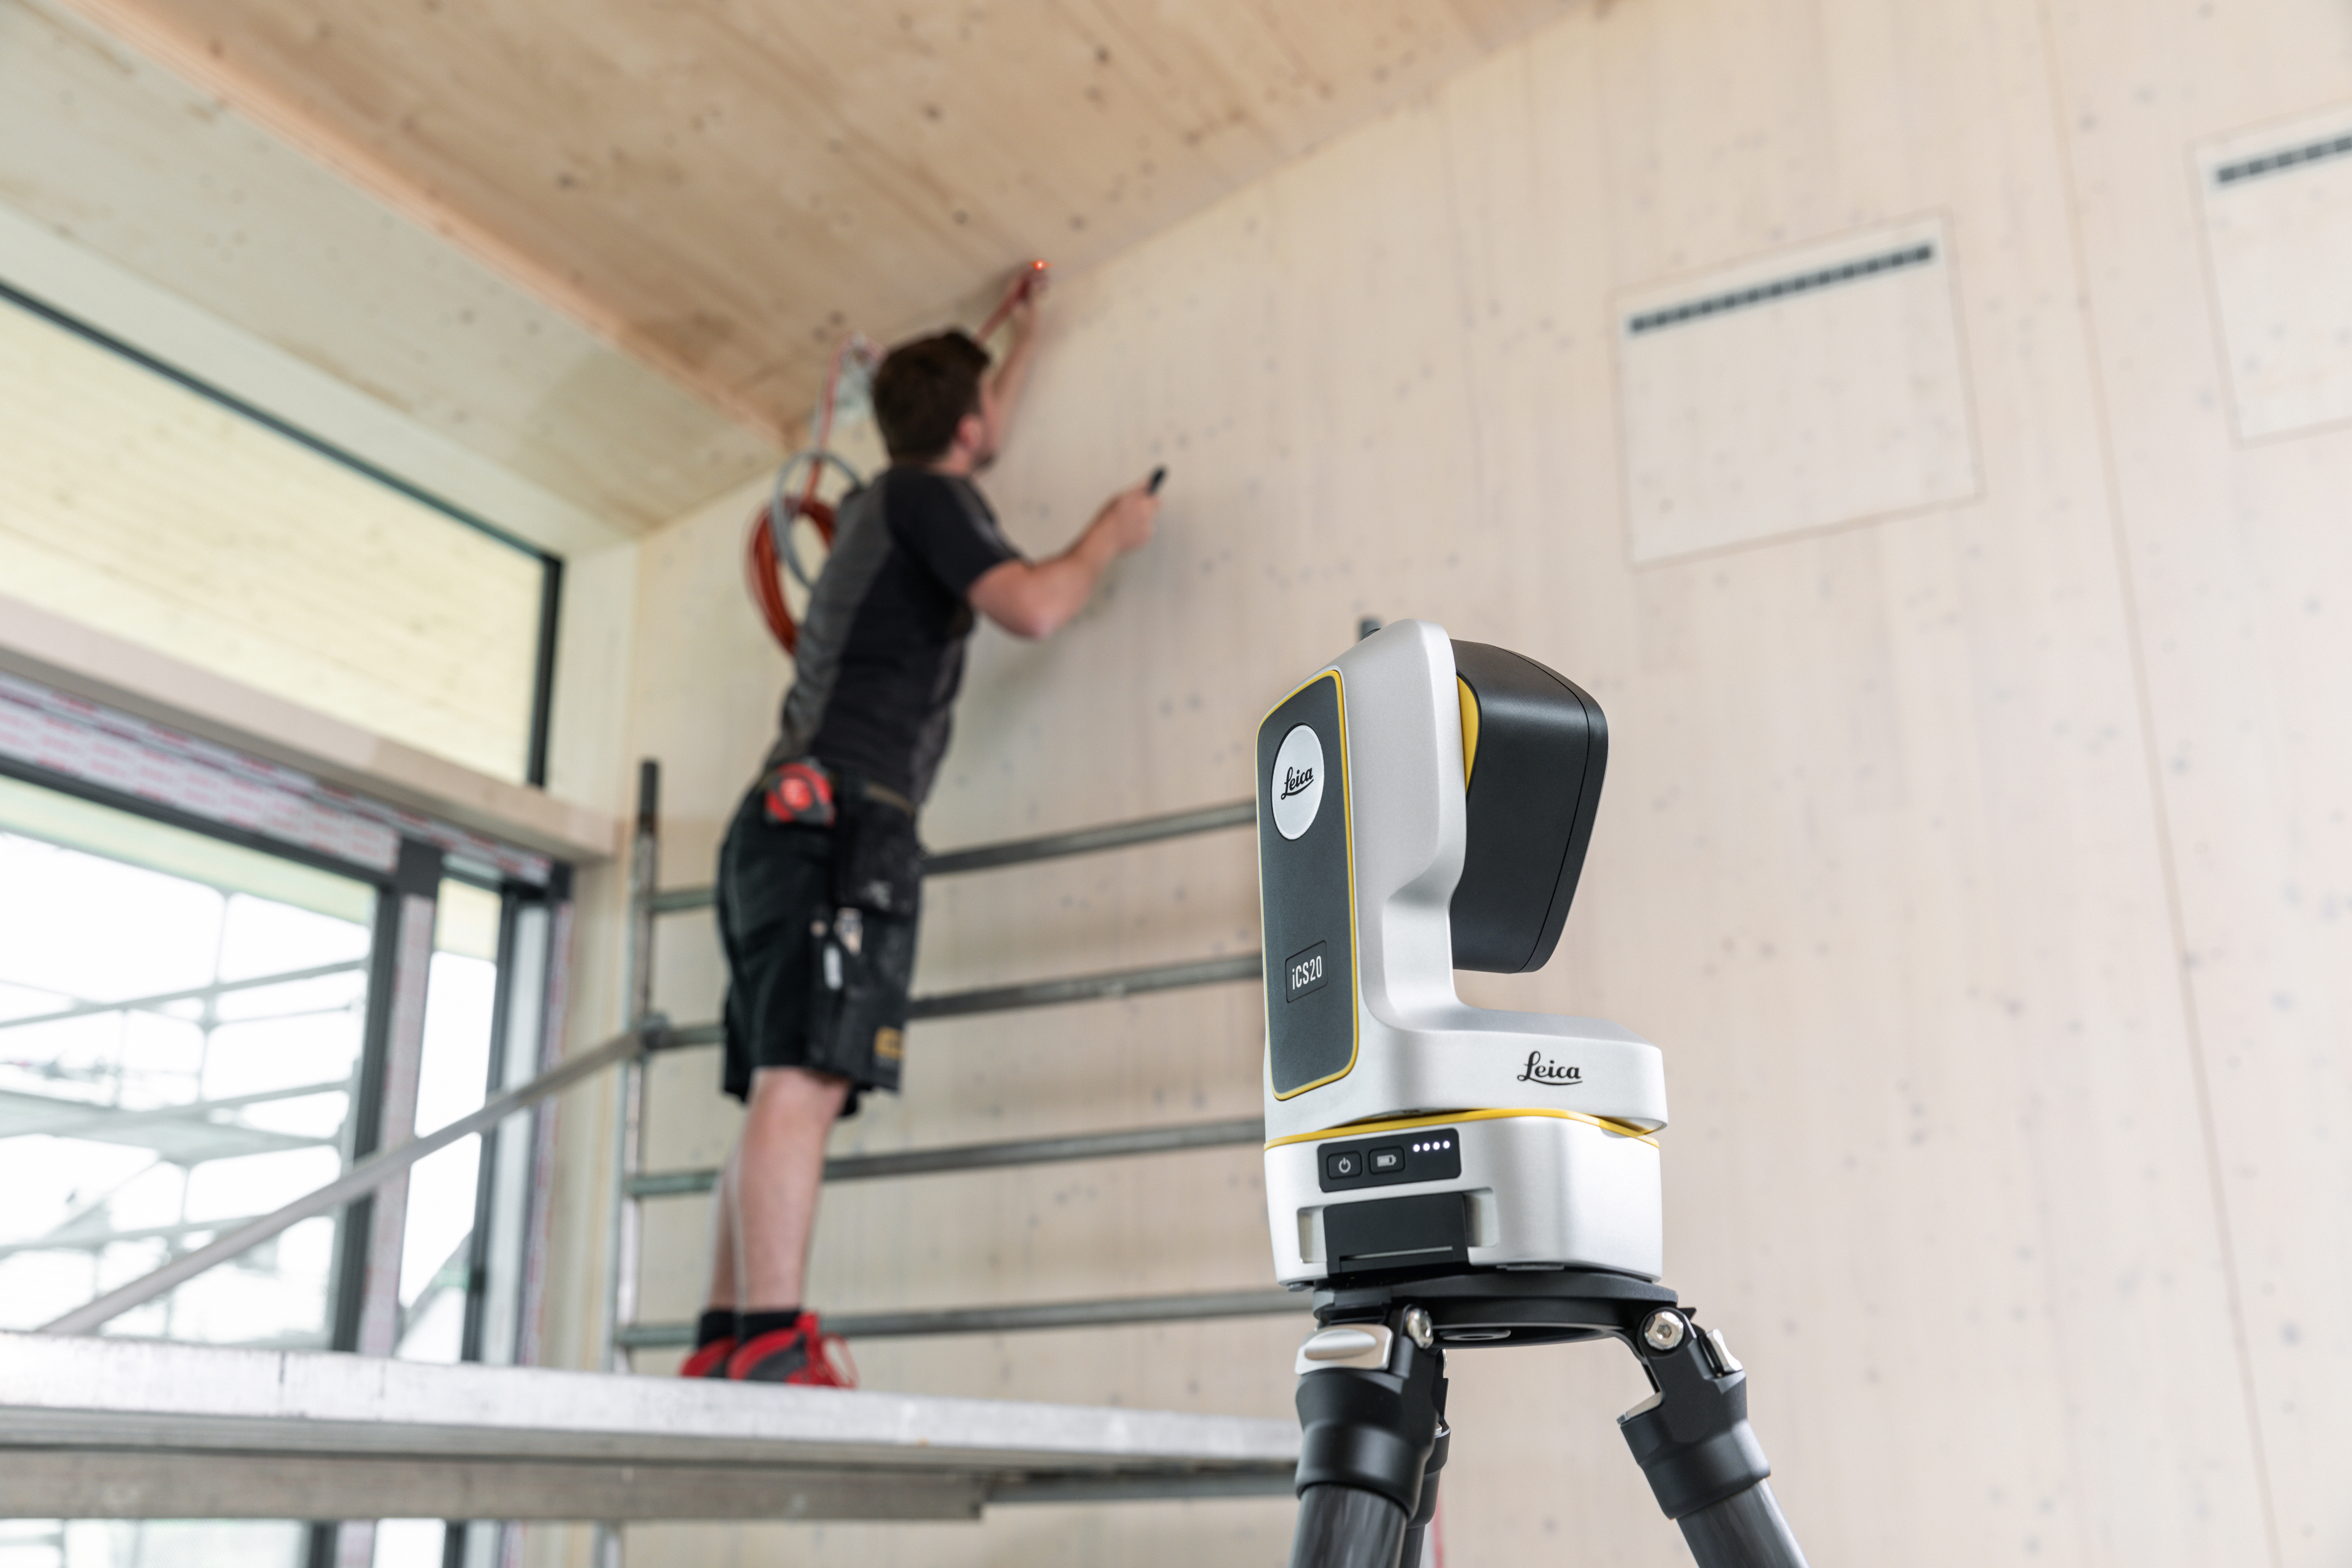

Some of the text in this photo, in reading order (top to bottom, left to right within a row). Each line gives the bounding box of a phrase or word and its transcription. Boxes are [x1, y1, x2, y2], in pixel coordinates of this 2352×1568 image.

[1281, 766, 1314, 800] Leica
[1292, 956, 1322, 990] iCS20
[1517, 1051, 1583, 1085] Leica
